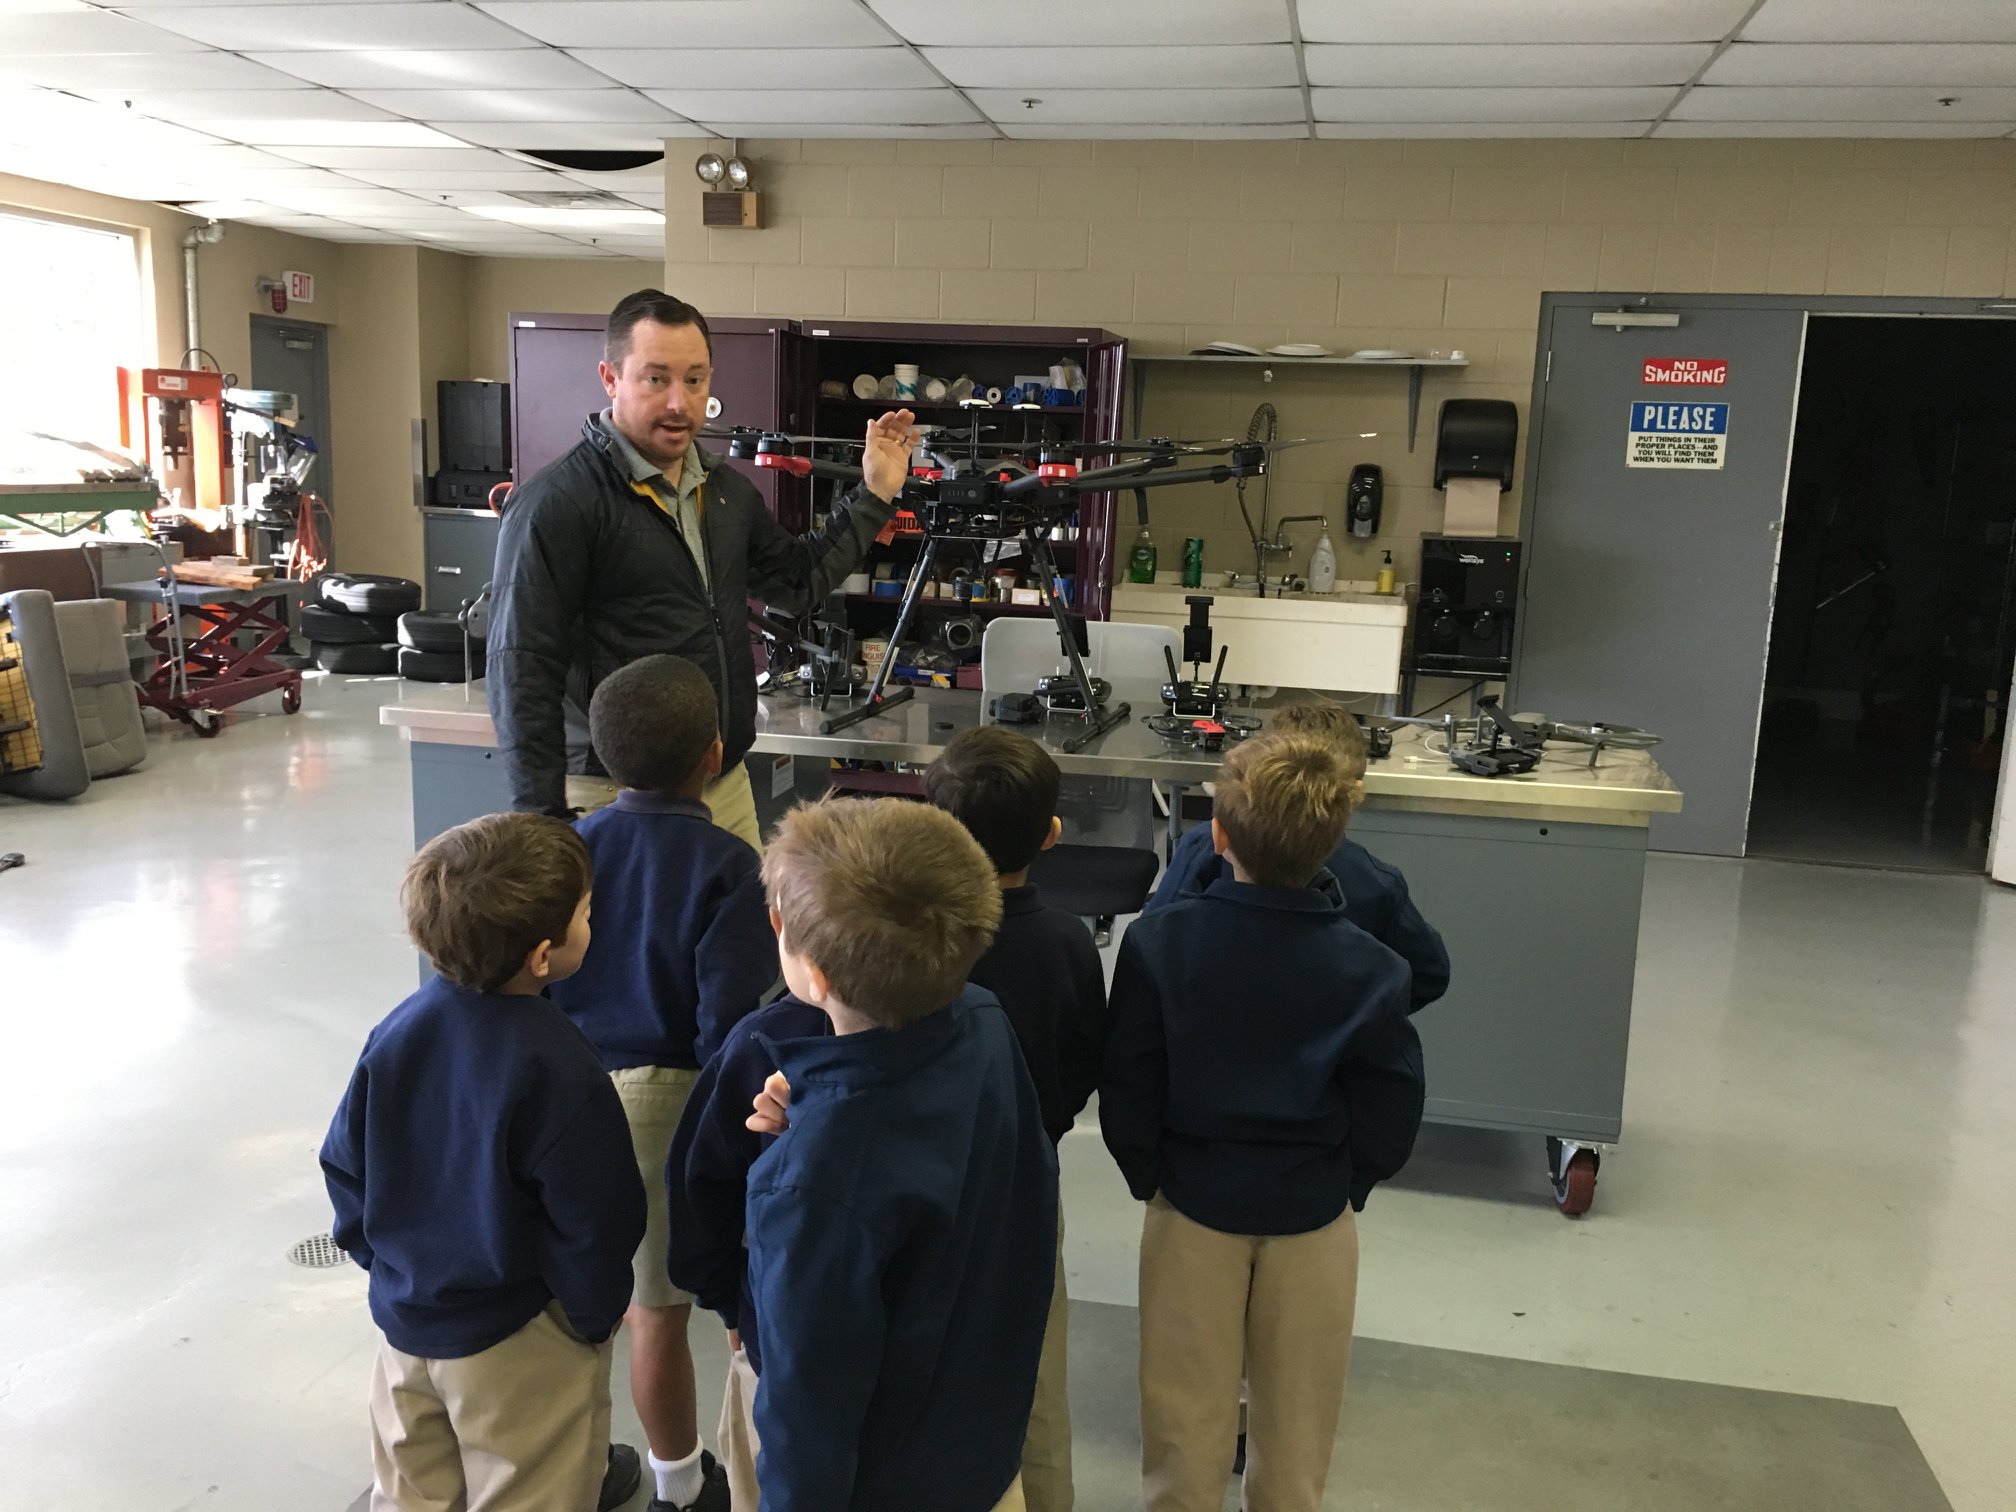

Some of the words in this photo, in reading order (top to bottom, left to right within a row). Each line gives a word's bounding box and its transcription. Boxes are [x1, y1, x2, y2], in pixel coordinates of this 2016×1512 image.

[293, 273, 310, 299] EXIT
[1644, 364, 1726, 383] SMOKING
[1673, 361, 1698, 371] NO
[1643, 405, 1716, 431] PLEASE
[865, 644, 881, 652] FIRE
